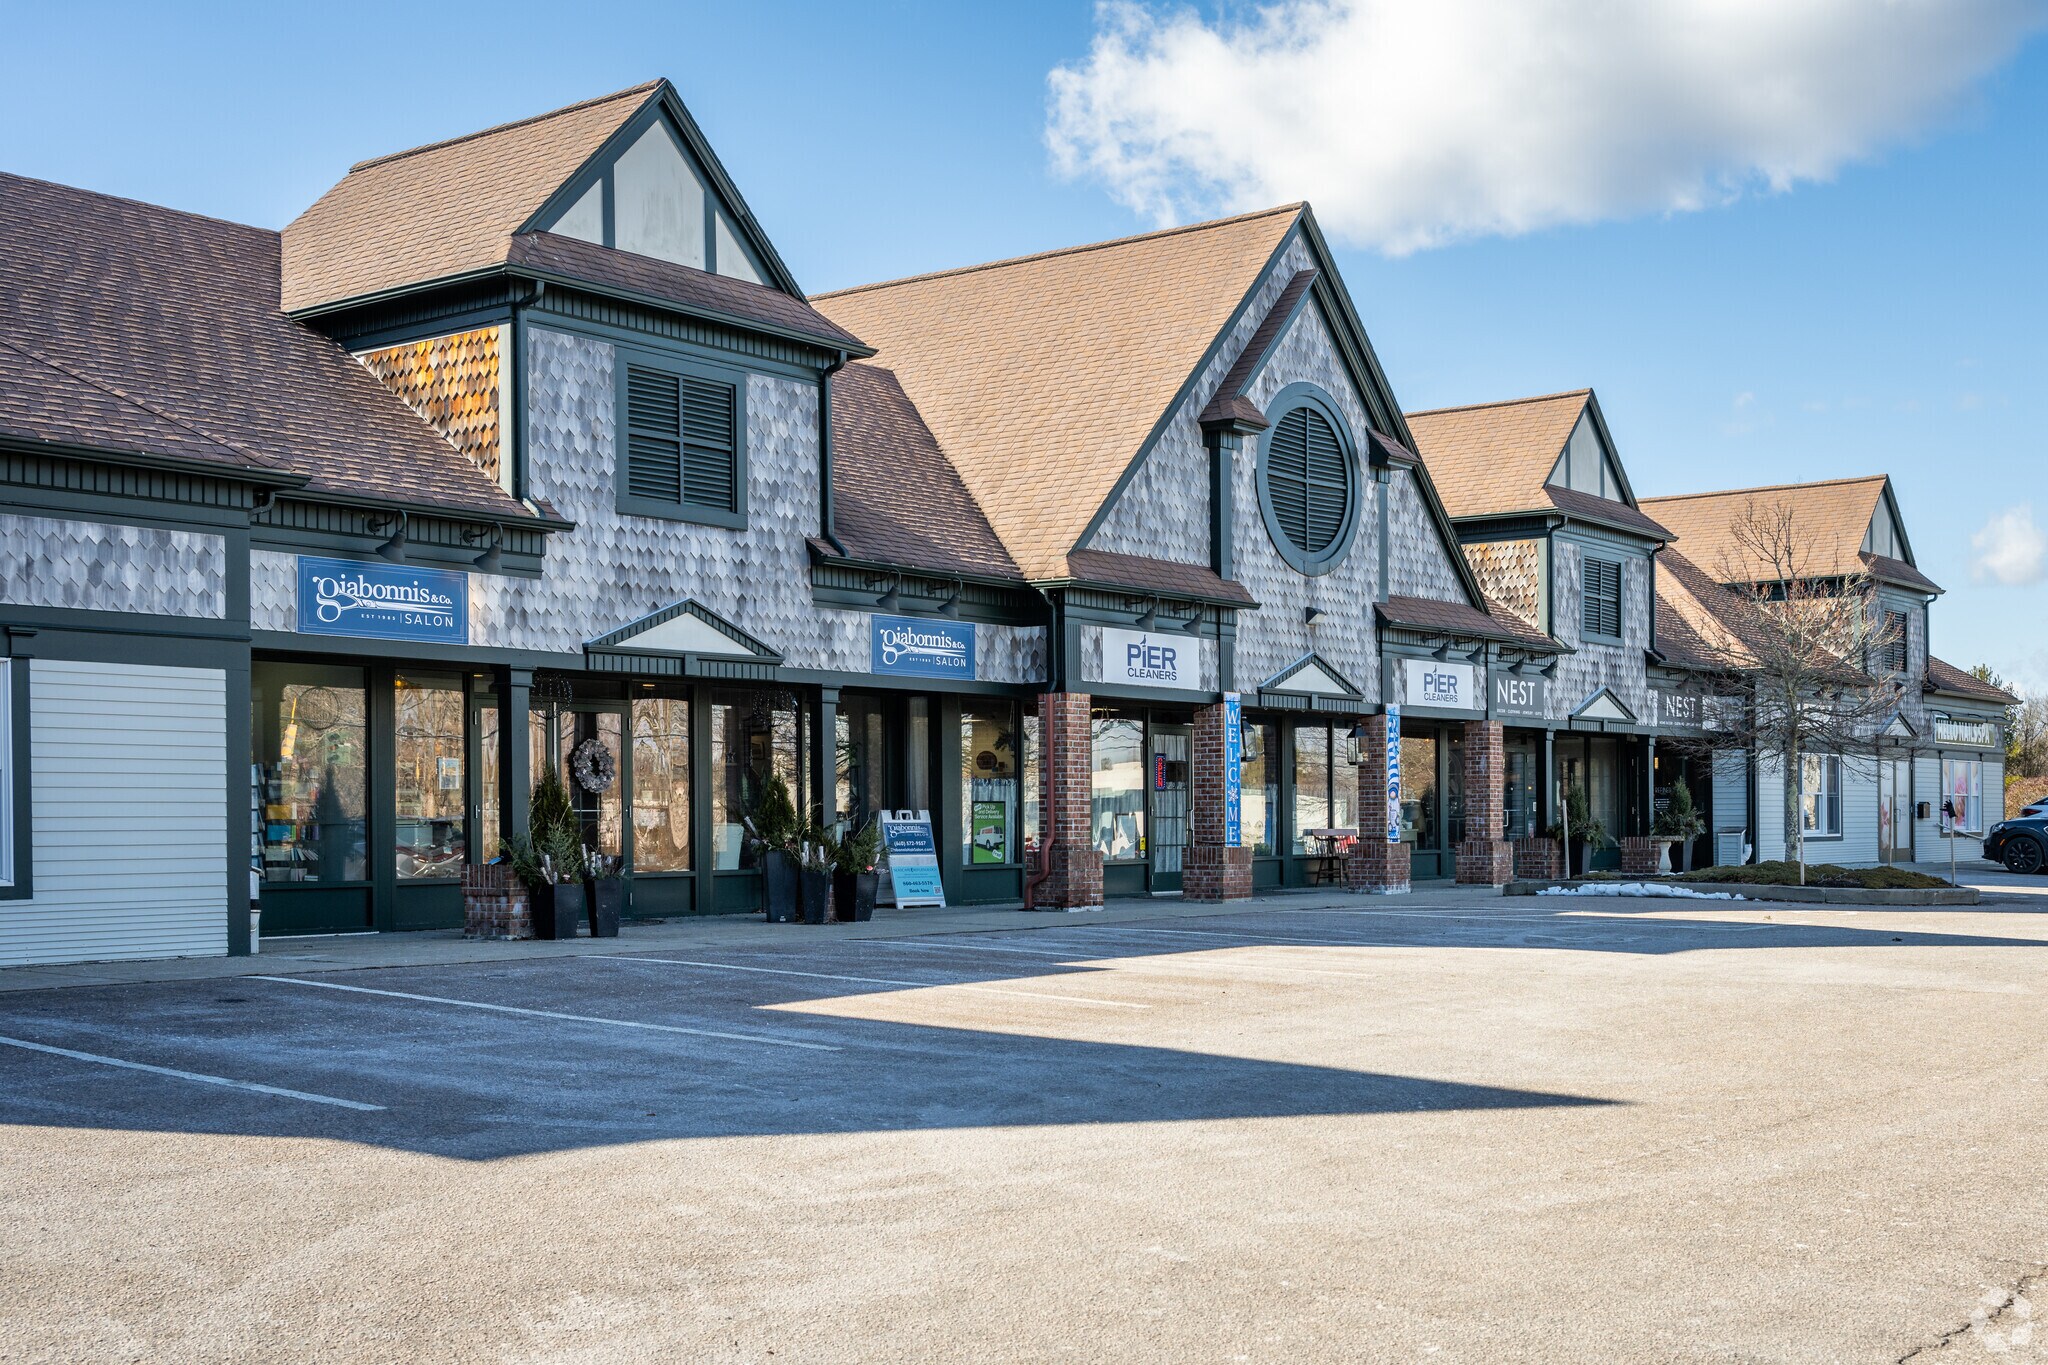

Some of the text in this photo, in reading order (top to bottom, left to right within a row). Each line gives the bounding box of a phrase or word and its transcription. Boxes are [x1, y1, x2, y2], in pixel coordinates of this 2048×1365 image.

[405, 613, 454, 628] SALON
[936, 656, 966, 667] SALON
[1127, 667, 1177, 681] CLEANERS
[1423, 692, 1458, 703] CLEANERS
[1497, 678, 1535, 706] NEST
[1666, 695, 1696, 718] NEST
[1937, 719, 1958, 741] HELLO
